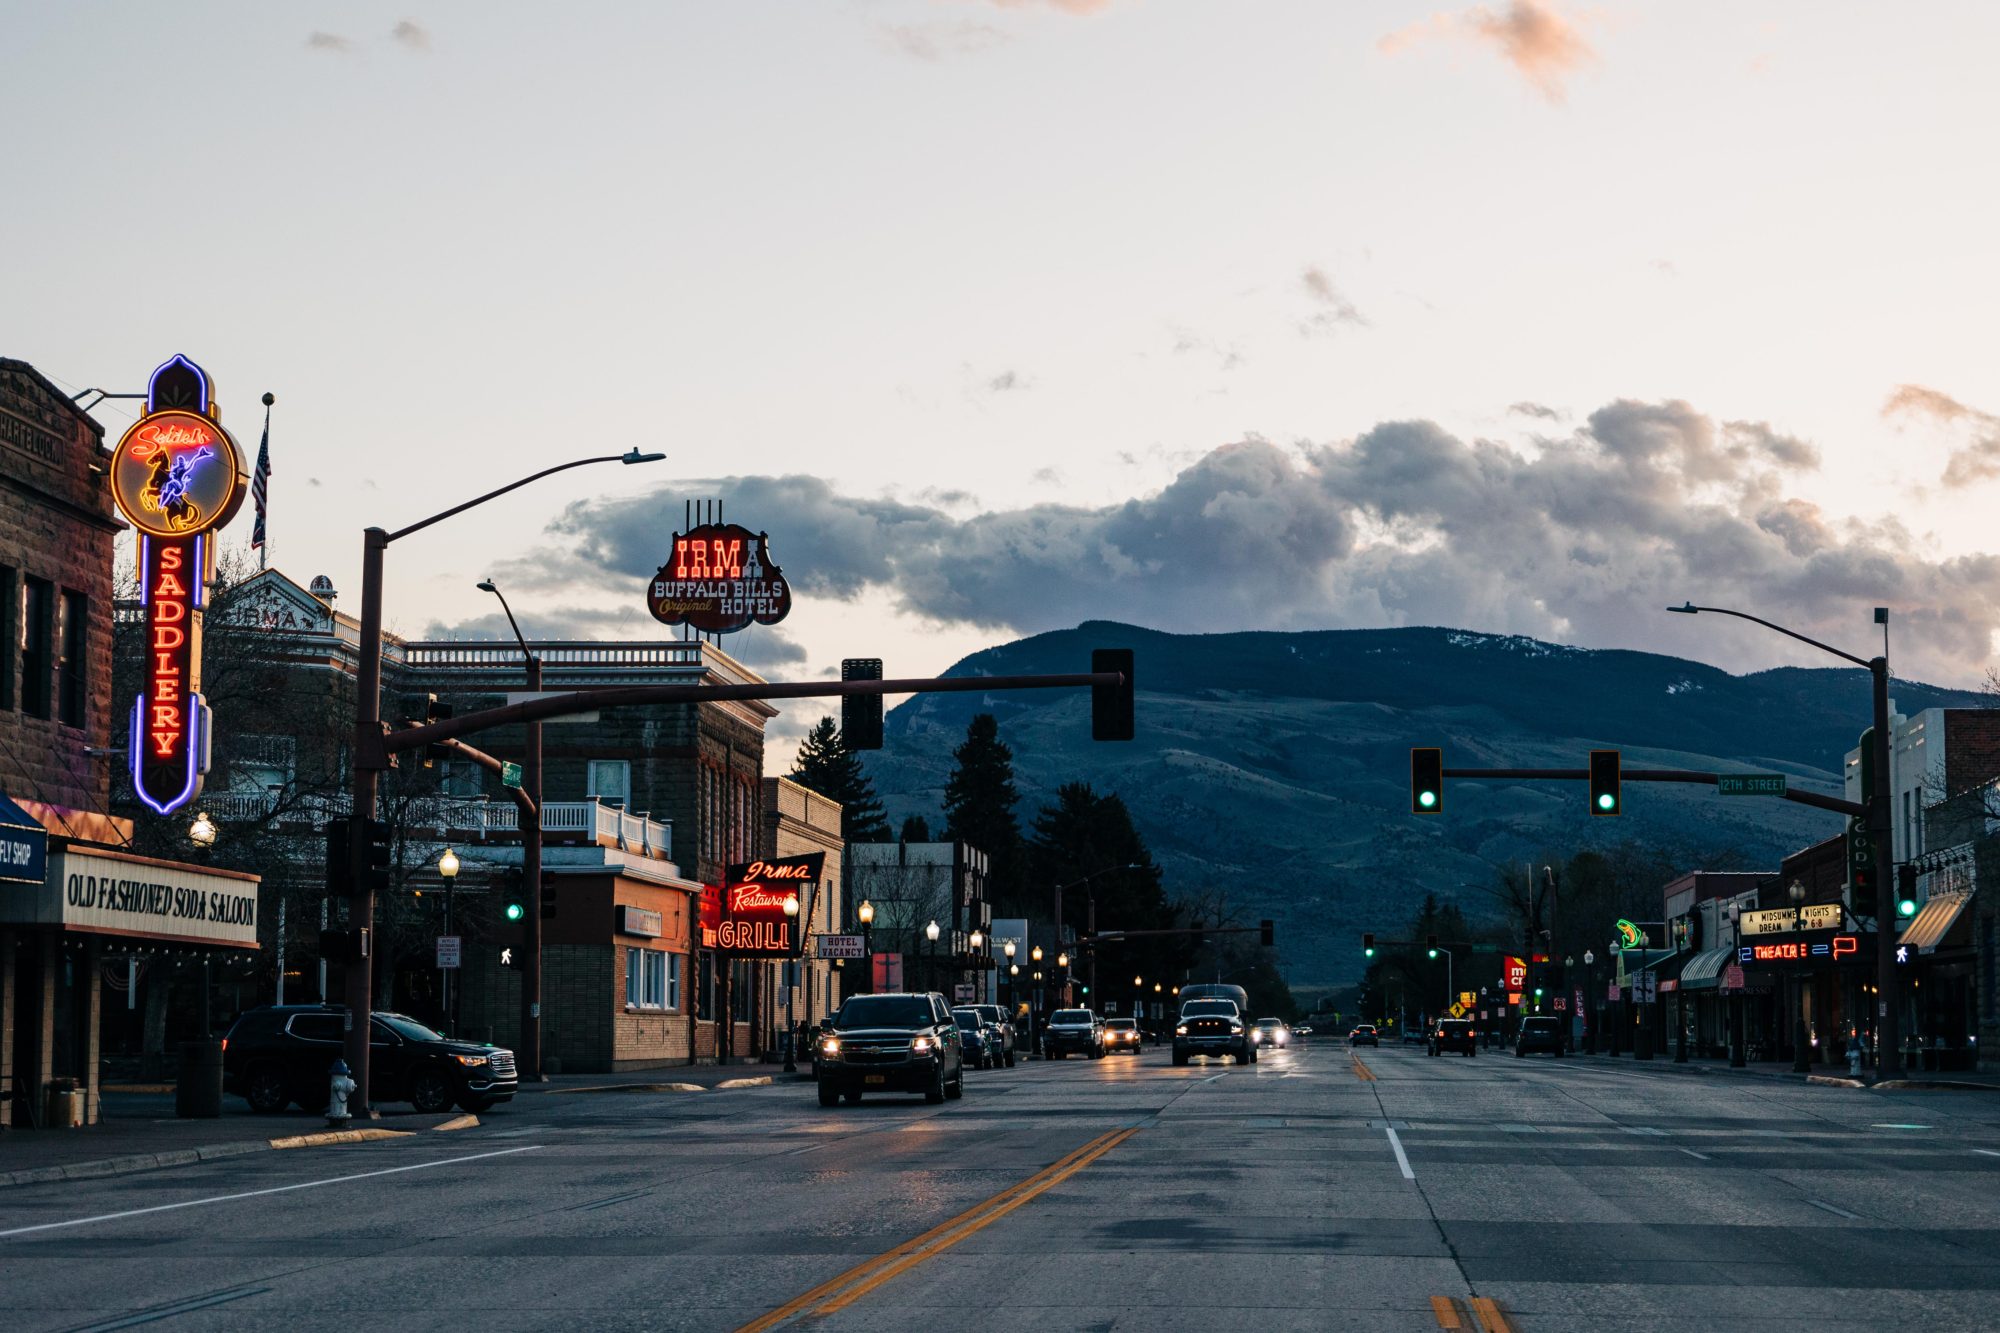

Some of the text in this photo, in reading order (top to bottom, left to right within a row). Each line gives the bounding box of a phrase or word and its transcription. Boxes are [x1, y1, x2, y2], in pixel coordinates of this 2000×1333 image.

[677, 539, 764, 579] IRMA
[654, 581, 783, 598] BUFFALO BILLS
[658, 598, 779, 615] Original HOTEL
[236, 607, 297, 628] IRMA
[152, 547, 186, 755] SADDLERY
[1719, 779, 1784, 791] 12TH STREET
[0, 839, 32, 866] FLY SHOP
[743, 862, 811, 882] Irma
[67, 873, 255, 926] OLD FASHIONED SODA SALOON
[733, 884, 796, 911] Restaura
[1761, 909, 1796, 921] MIDSUMME
[1805, 907, 1829, 918] NIGHTS
[718, 921, 789, 949] GRILL
[1759, 922, 1782, 932] DREAM
[822, 947, 862, 957] VACANCY
[1753, 943, 1807, 959] THEATRE
